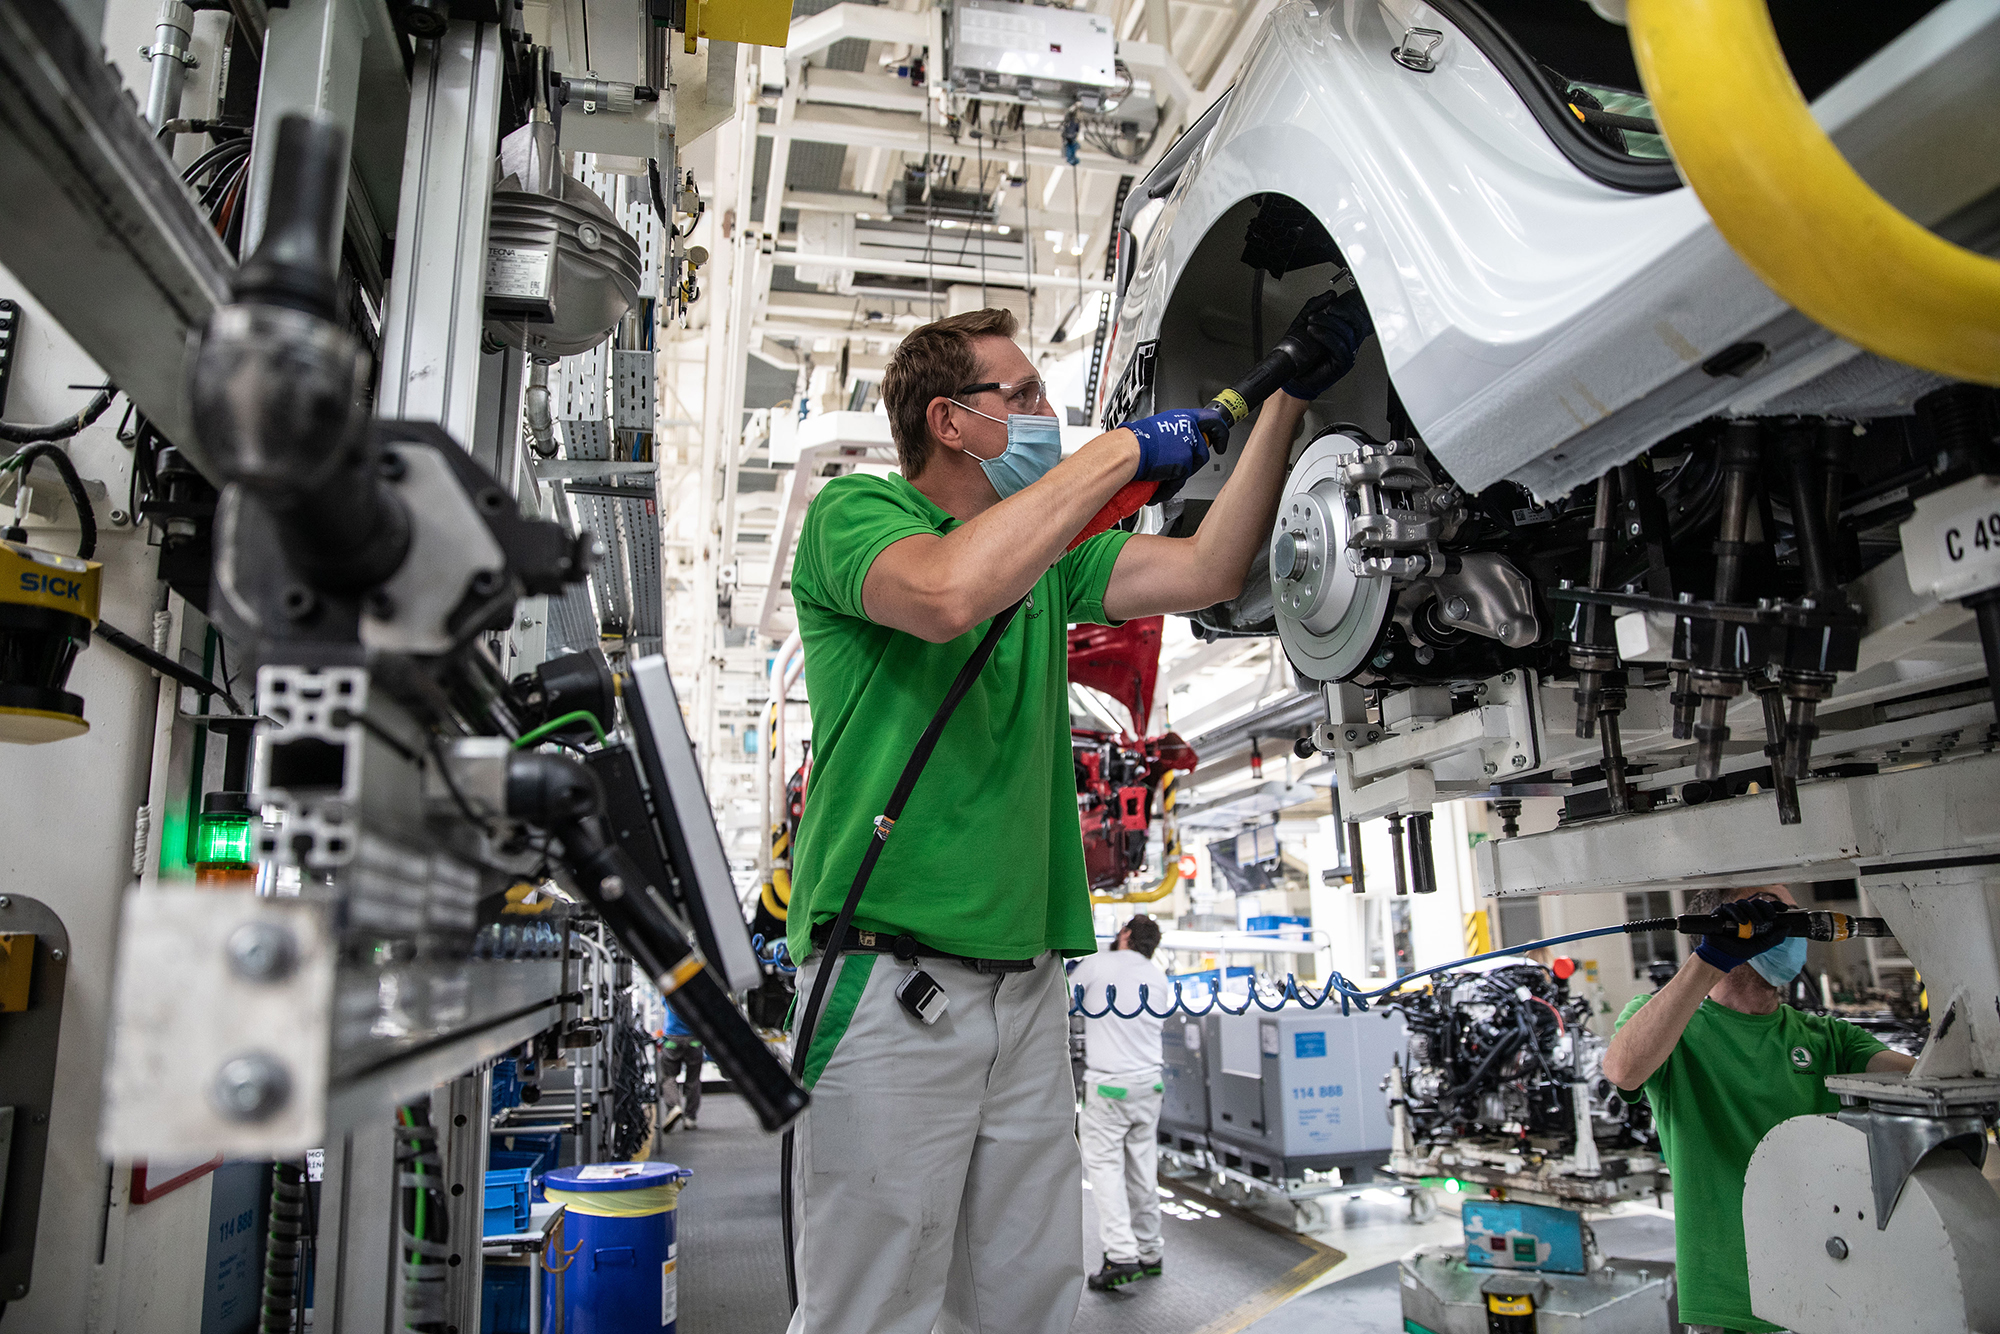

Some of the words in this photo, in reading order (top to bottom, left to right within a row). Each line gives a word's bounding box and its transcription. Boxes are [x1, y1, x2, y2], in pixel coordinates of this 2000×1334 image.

[488, 248, 515, 256] TECNA
[1946, 528, 1964, 561] C
[20, 572, 81, 601] SICK
[1293, 1087, 1314, 1099] 114
[1319, 1085, 1343, 1098] 888
[220, 1217, 235, 1243] 114
